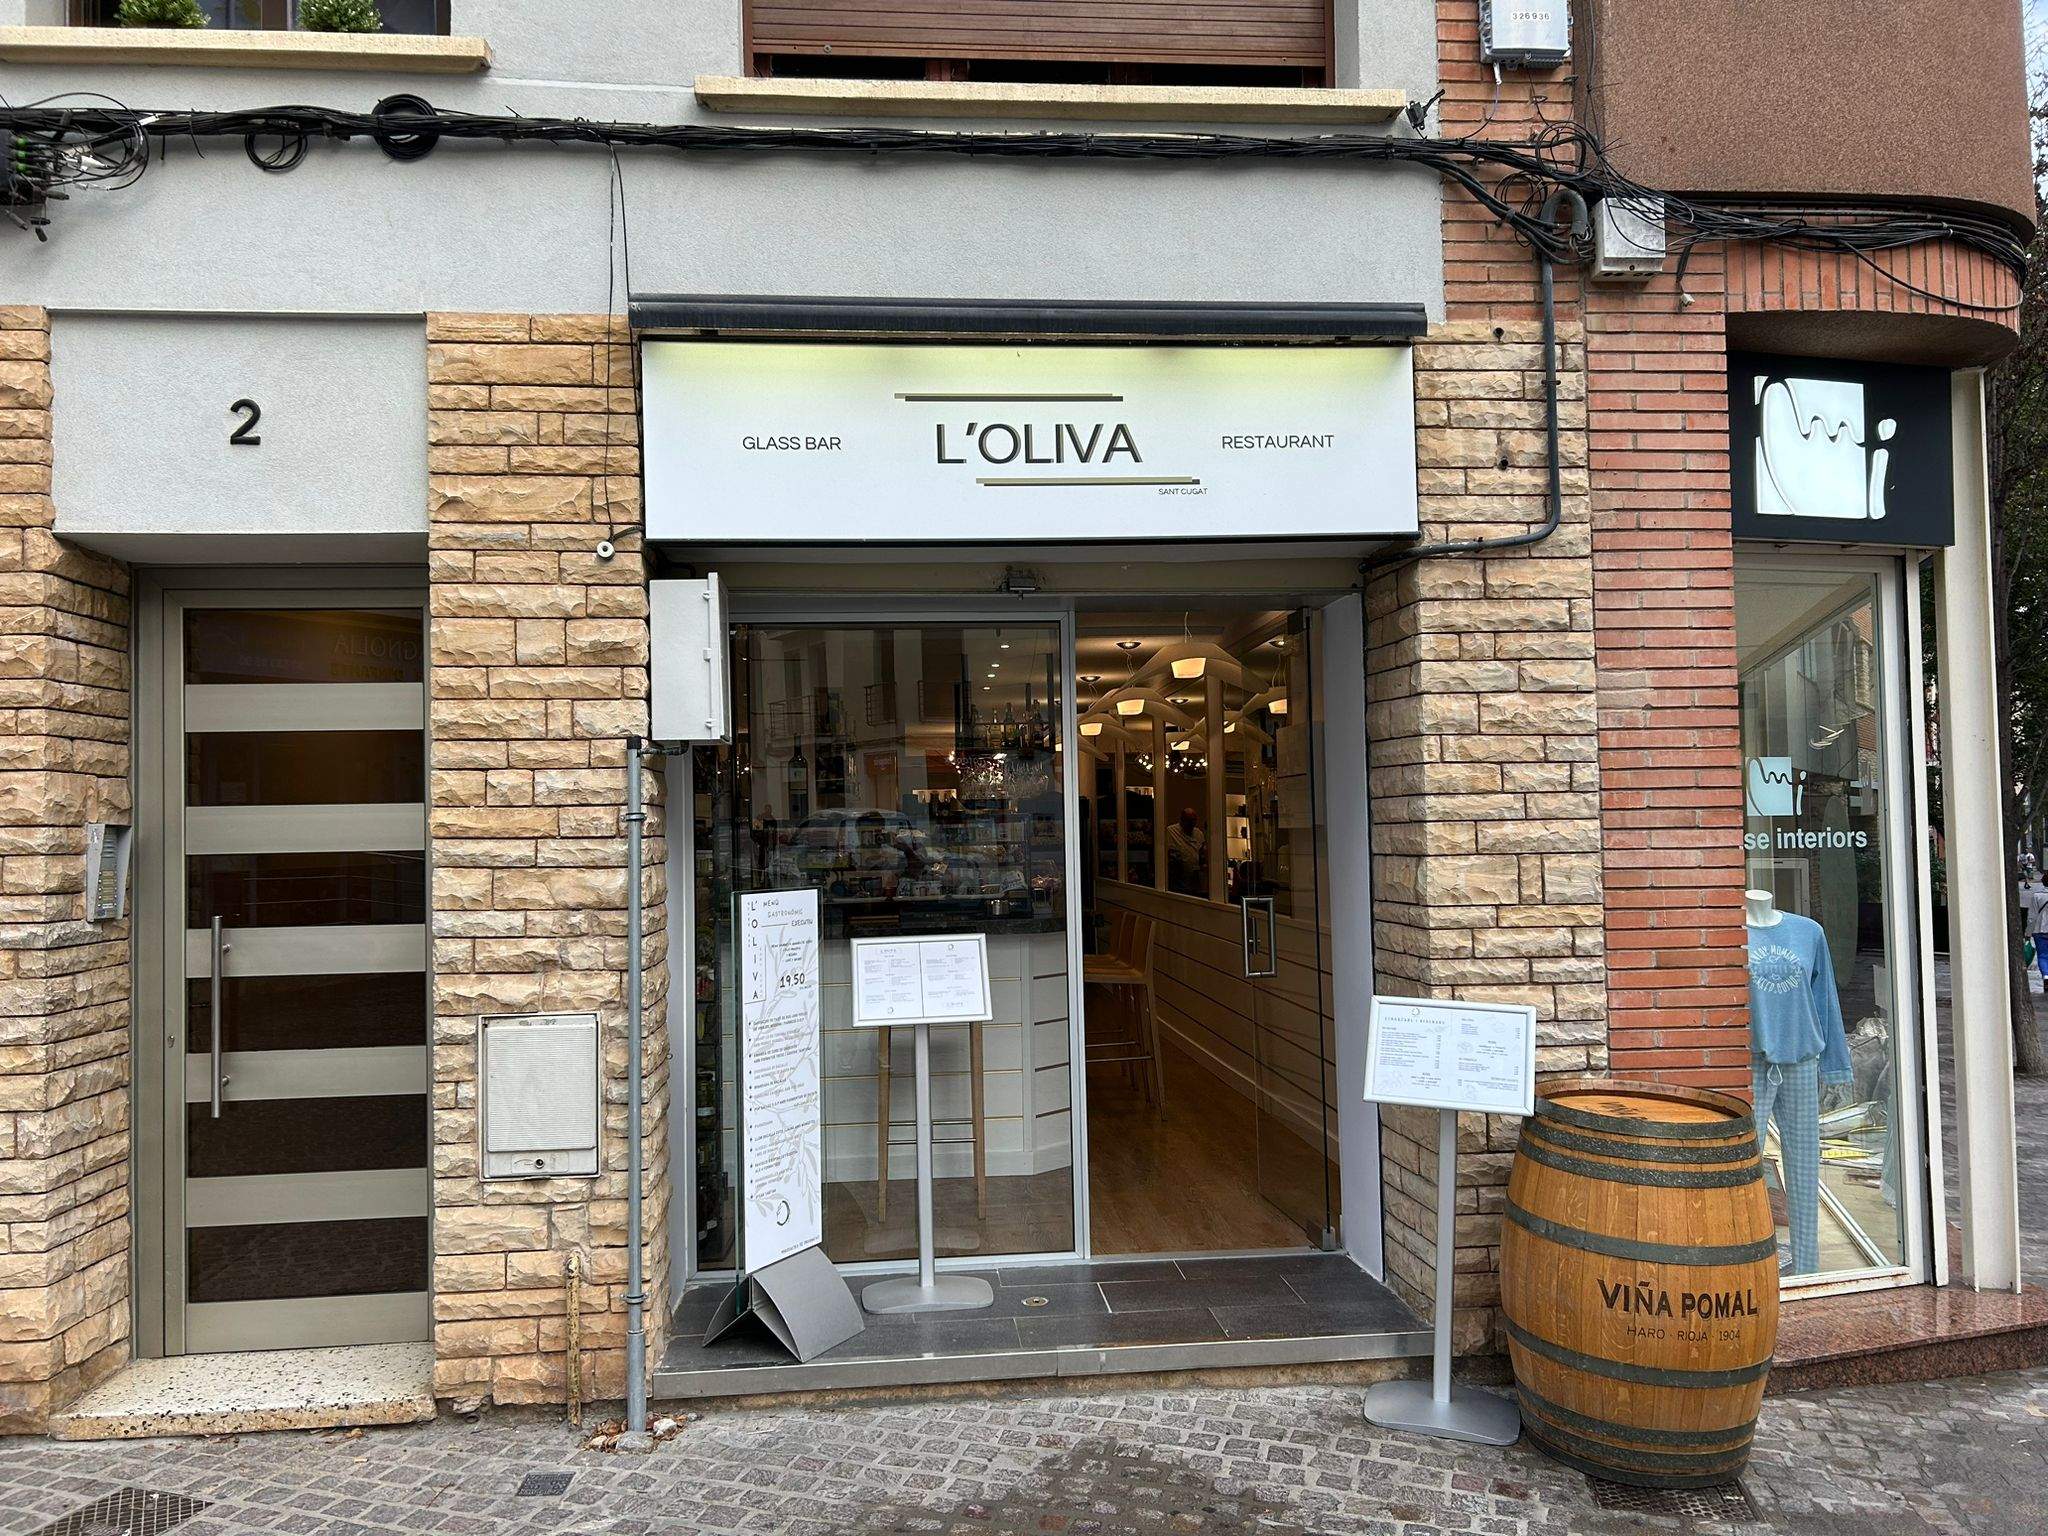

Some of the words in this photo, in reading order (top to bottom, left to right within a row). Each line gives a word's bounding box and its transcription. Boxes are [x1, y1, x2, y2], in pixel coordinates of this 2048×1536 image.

[1512, 12, 1550, 20] 326936
[230, 399, 261, 446] 2
[742, 436, 800, 450] GLASS
[805, 436, 841, 450] BAR
[936, 422, 1144, 464] L'OLIVA
[1221, 435, 1335, 449] RESTAURANT
[1776, 827, 1868, 849] interiors
[1597, 1278, 1673, 1318] VIÑA
[1681, 1288, 1758, 1319] POMAL
[1627, 1326, 1665, 1340] HARO
[1677, 1330, 1708, 1342] RIOJA
[1719, 1329, 1740, 1342] 1904
